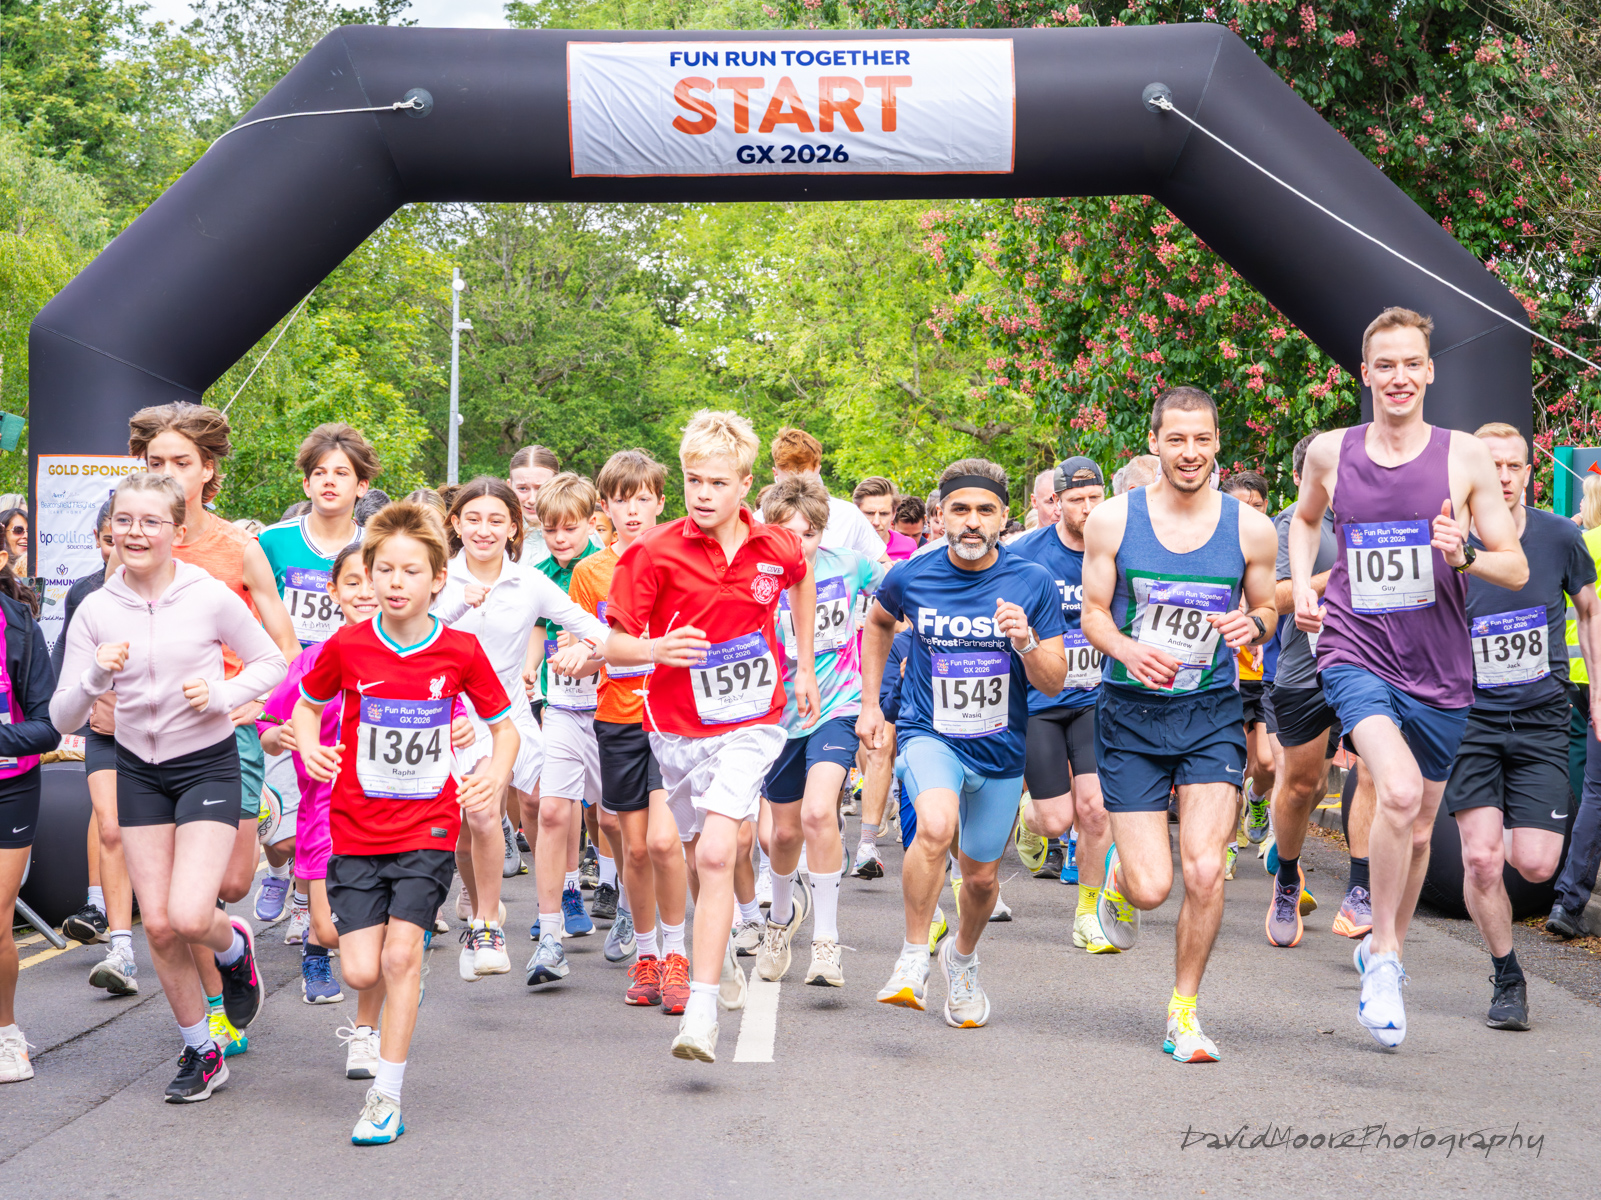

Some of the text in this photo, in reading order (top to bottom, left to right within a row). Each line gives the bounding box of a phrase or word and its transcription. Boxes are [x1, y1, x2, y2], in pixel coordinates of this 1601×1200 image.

[670, 50, 910, 67] FUN RUN TOGETHER
[672, 75, 913, 135] START
[736, 144, 850, 164] GX 2026
[48, 465, 79, 476] GOLD
[1392, 527, 1419, 535] Together
[1389, 535, 1406, 543] 2026
[1355, 547, 1420, 582] 1051
[1172, 588, 1223, 600] Fun Run Together
[290, 590, 345, 621] 1584
[918, 606, 1006, 638] Frost
[1151, 605, 1220, 642] 1487
[1515, 613, 1539, 621] Together
[1513, 621, 1528, 629] 2026
[735, 637, 760, 651] Together
[1167, 638, 1193, 649] Andrew
[1481, 629, 1543, 663] 1398
[735, 649, 751, 658] 2026
[976, 658, 1003, 667] Together
[700, 657, 773, 698] 1592
[940, 677, 1003, 710] 1543
[384, 706, 444, 716] Fun Run Together
[399, 716, 431, 724] GX 2026
[368, 727, 442, 765] 1364
[392, 768, 416, 776] Rapha
